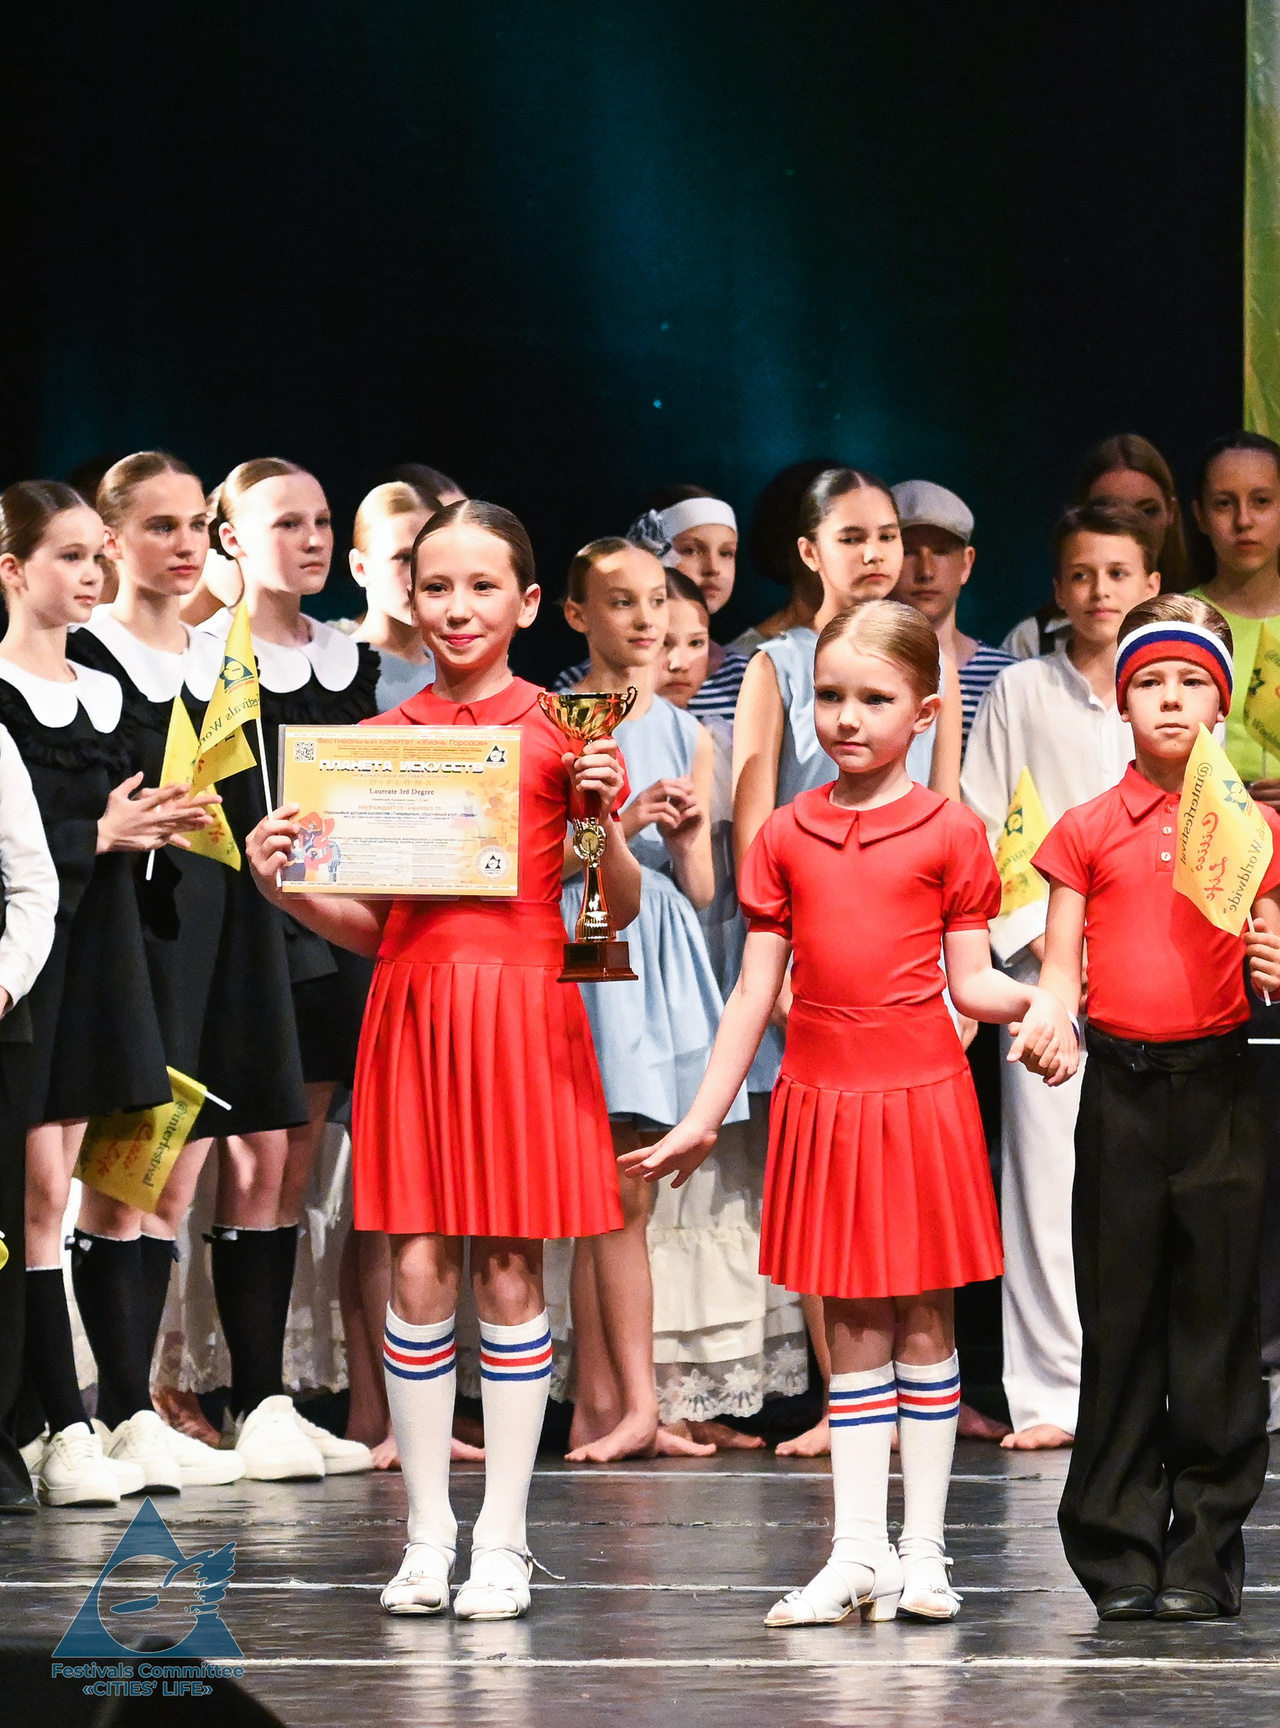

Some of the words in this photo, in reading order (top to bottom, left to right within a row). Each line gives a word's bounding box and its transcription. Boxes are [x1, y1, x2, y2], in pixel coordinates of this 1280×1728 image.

[319, 759, 393, 773] ПЛАНЕТА
[400, 760, 485, 774] ИСКУССТВ
[411, 788, 434, 796] Degree
